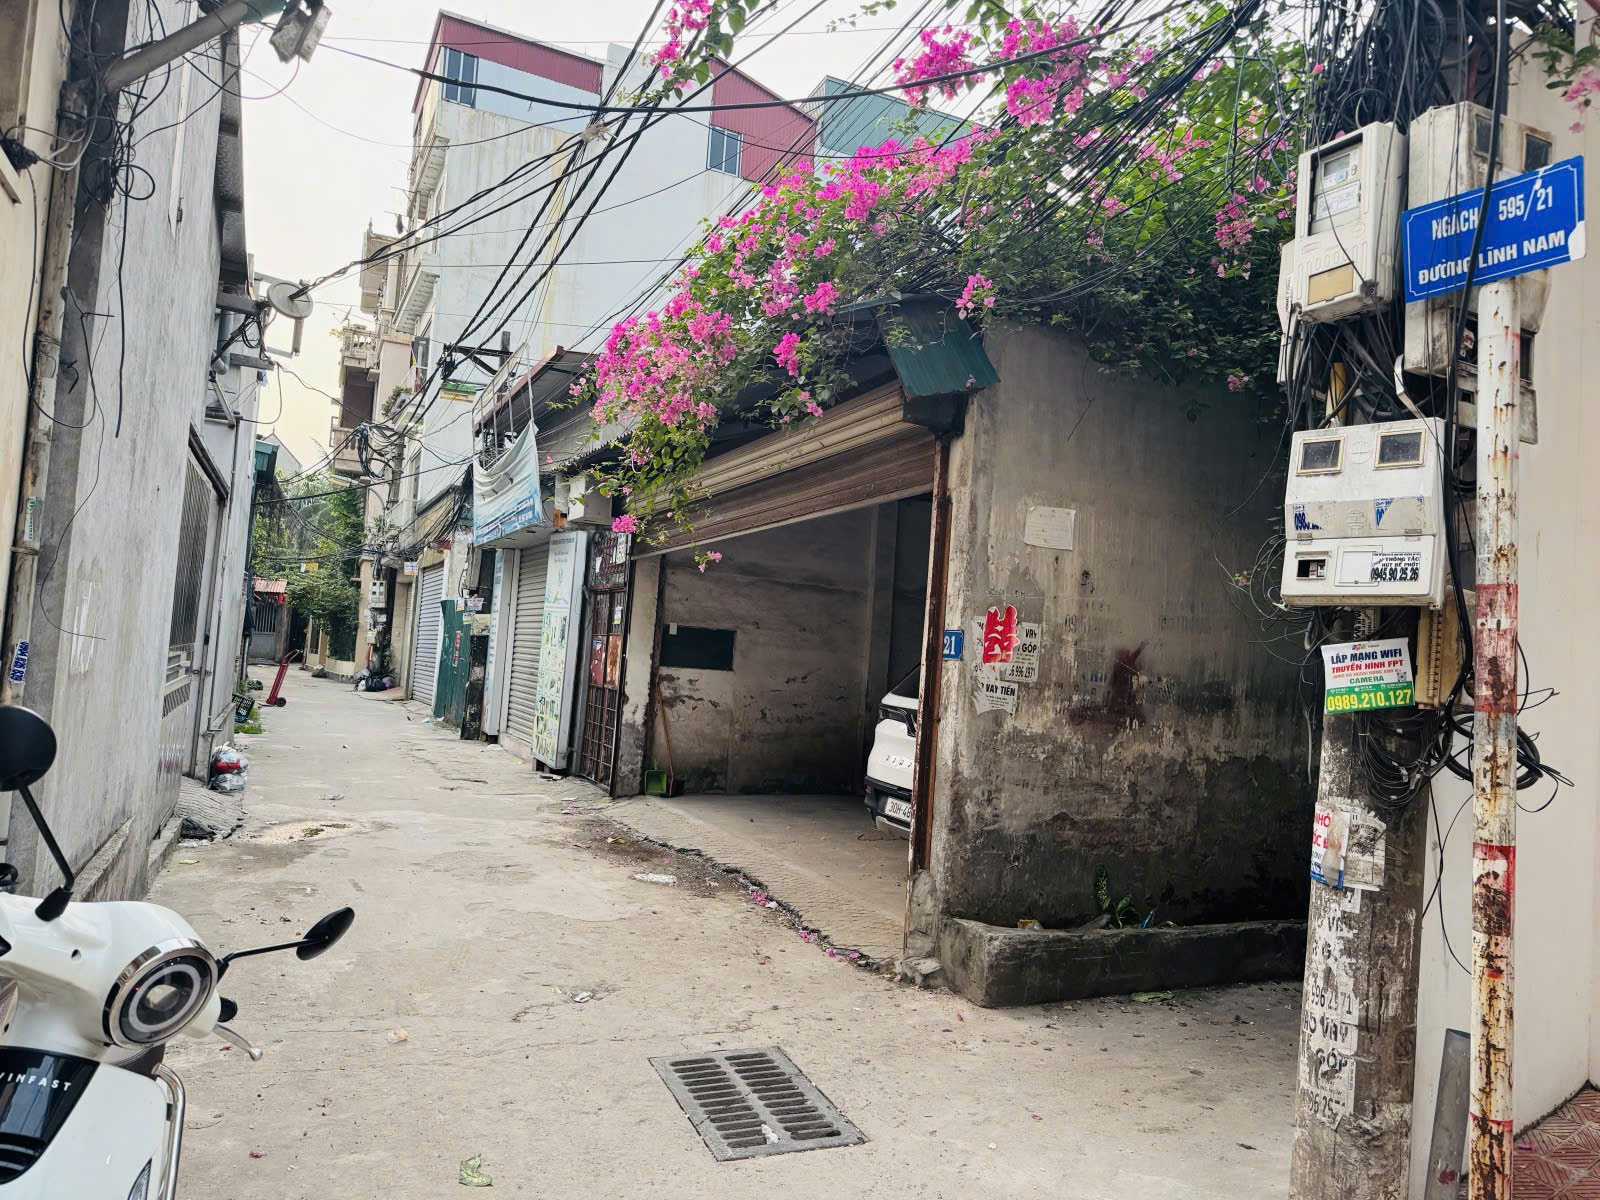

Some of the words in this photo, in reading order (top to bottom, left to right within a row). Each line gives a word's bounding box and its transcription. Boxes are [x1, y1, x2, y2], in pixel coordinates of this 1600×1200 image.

[1432, 207, 1479, 241] NGÁCH
[1498, 185, 1553, 221] 595/21
[1418, 257, 1471, 285] ĐƯỜNG
[1478, 246, 1518, 269] LĨNH
[1523, 230, 1565, 256] NAM
[943, 635, 956, 655] 21
[1021, 642, 1037, 654] GÓP
[1331, 653, 1347, 664] LẮP
[1350, 650, 1377, 662] MẠNG
[1380, 648, 1402, 658] WIFI
[1365, 661, 1385, 670] HÌNH
[1350, 675, 1384, 684] CAMERA
[986, 683, 998, 694] VAY
[1327, 688, 1412, 711] 0989.210.127
